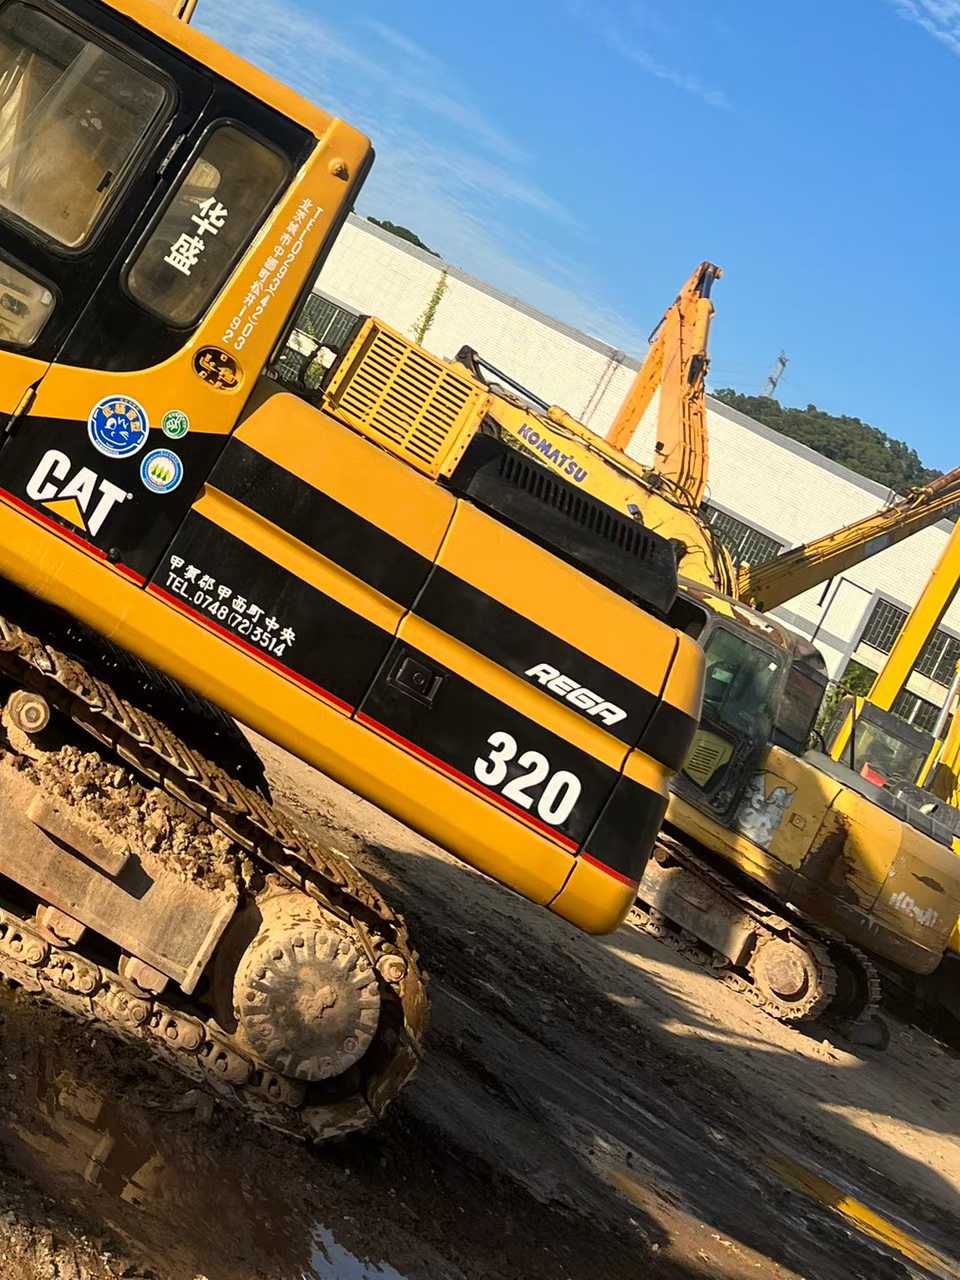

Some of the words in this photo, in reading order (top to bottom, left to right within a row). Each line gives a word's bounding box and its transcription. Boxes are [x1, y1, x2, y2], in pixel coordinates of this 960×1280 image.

[163, 196, 229, 277] 华盛
[25, 448, 126, 537] CAT
[518, 423, 588, 483] KOMATSU
[524, 662, 628, 726] REGA
[473, 730, 582, 827] 320
